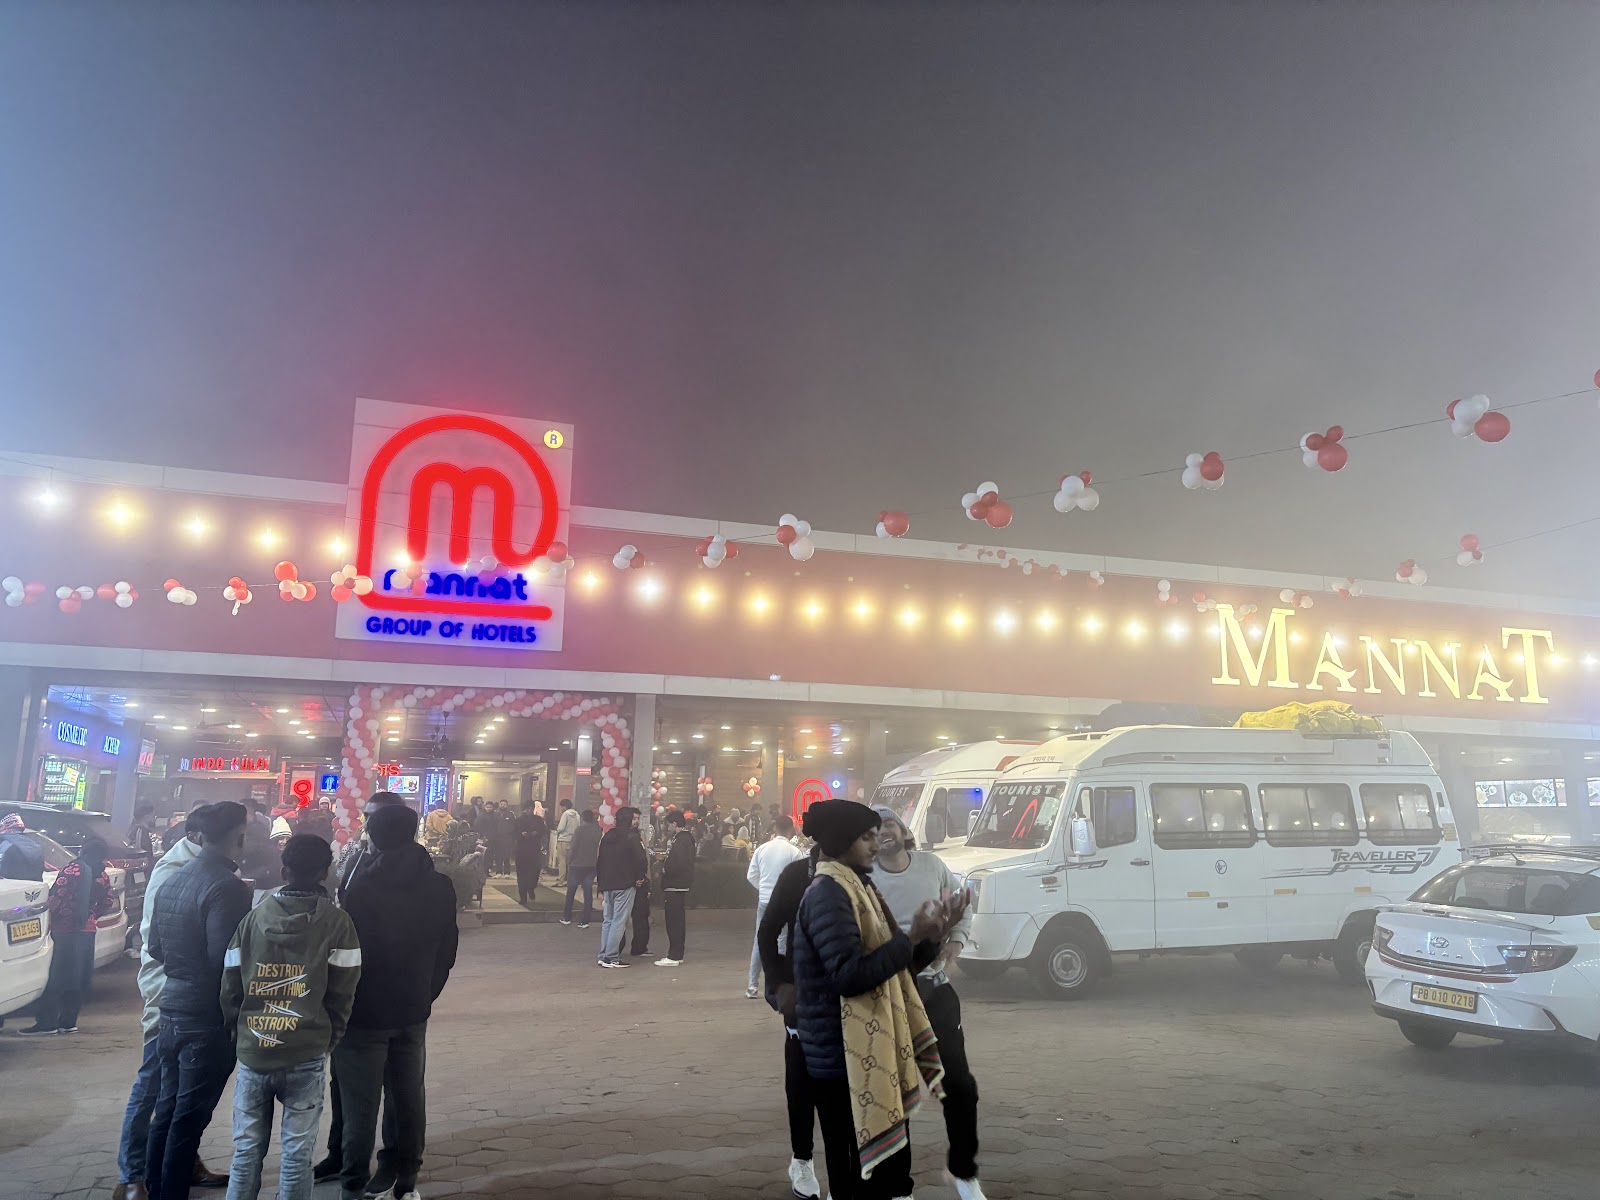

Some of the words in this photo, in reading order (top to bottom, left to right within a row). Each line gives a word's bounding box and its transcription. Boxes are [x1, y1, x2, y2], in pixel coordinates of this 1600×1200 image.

[366, 616, 432, 636] GROUP
[439, 620, 464, 638] OF
[471, 623, 537, 643] HOTELS
[1211, 603, 1555, 704] MANNAT
[878, 786, 909, 798] TOURIST
[994, 784, 1056, 796] TOURIST
[1331, 848, 1417, 862] TRAVELLER
[257, 963, 306, 978] DESTROY
[1417, 988, 1429, 1000] PB
[247, 1015, 299, 1031] DESTROYS
